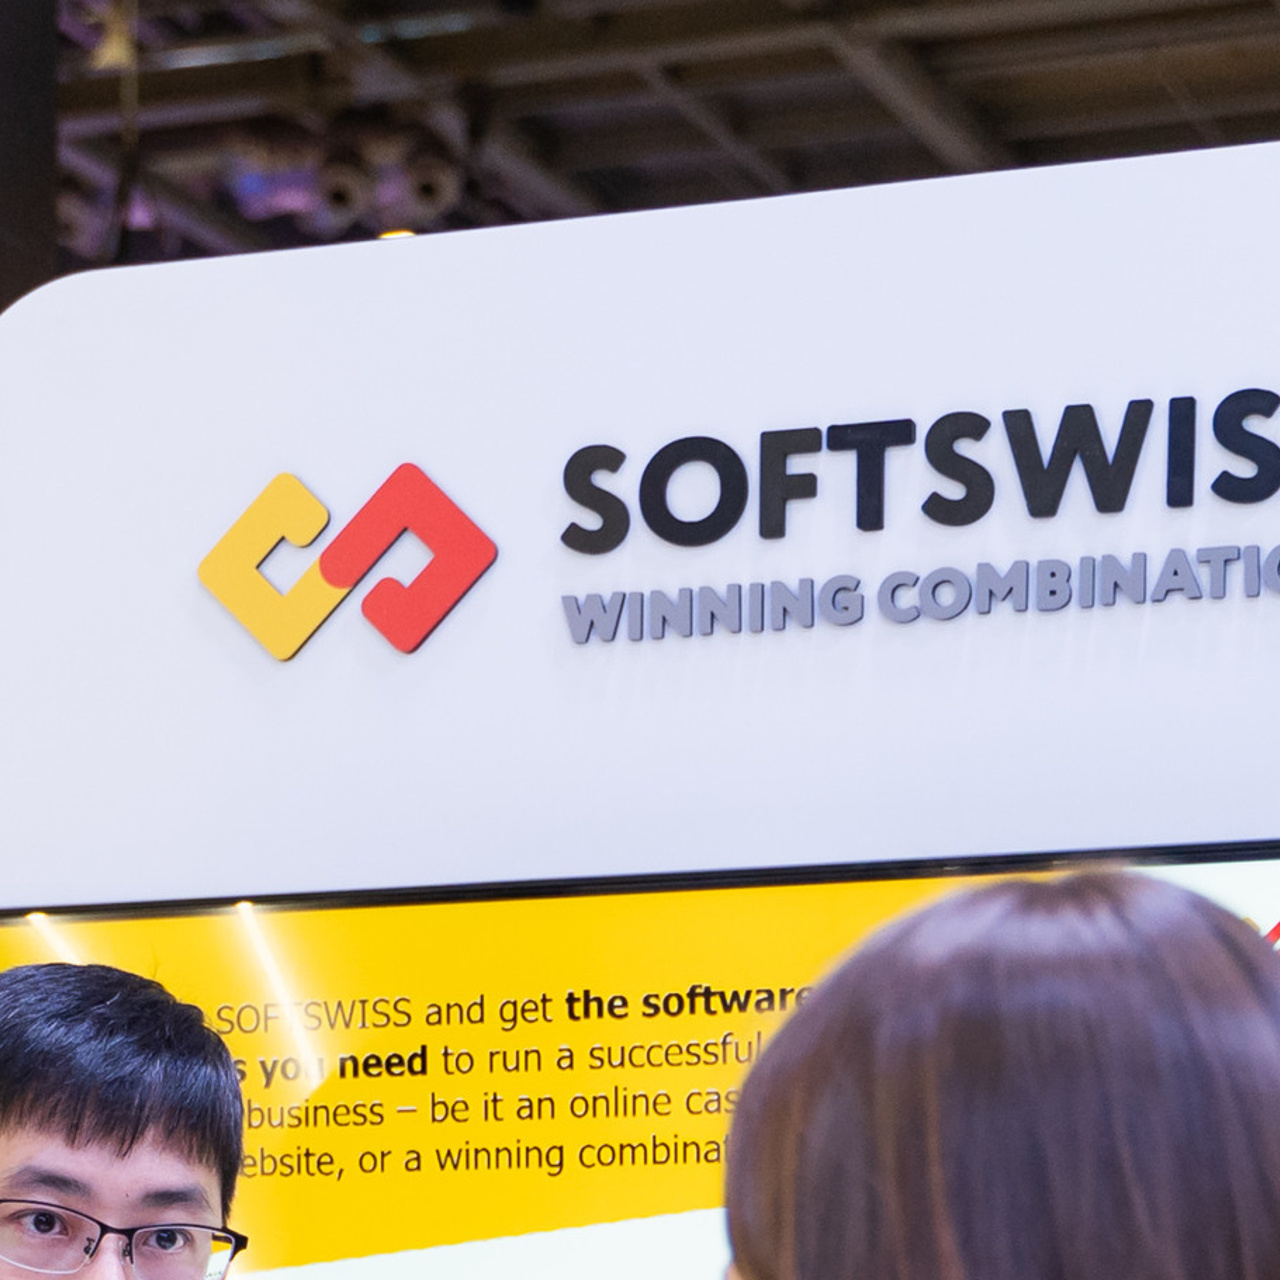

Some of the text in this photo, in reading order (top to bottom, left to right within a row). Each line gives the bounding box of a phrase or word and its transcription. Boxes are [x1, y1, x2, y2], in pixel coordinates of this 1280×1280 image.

[561, 575, 865, 644] WINNING
[216, 996, 412, 1035] SOFSWISS
[425, 993, 485, 1026] and
[499, 992, 554, 1032] get
[565, 988, 629, 1021] the
[338, 1043, 428, 1079] need
[441, 1045, 474, 1075] to
[489, 1047, 542, 1074] run
[556, 1045, 574, 1070] a
[589, 1030, 762, 1070] successful
[247, 1098, 385, 1130] business
[430, 1091, 470, 1123] be
[483, 1091, 504, 1121] it
[516, 1096, 555, 1120] an
[569, 1085, 672, 1119] online
[238, 1146, 345, 1181] ebsite,
[358, 1149, 392, 1174] or
[404, 1149, 422, 1172] a
[435, 1138, 564, 1177] winning
